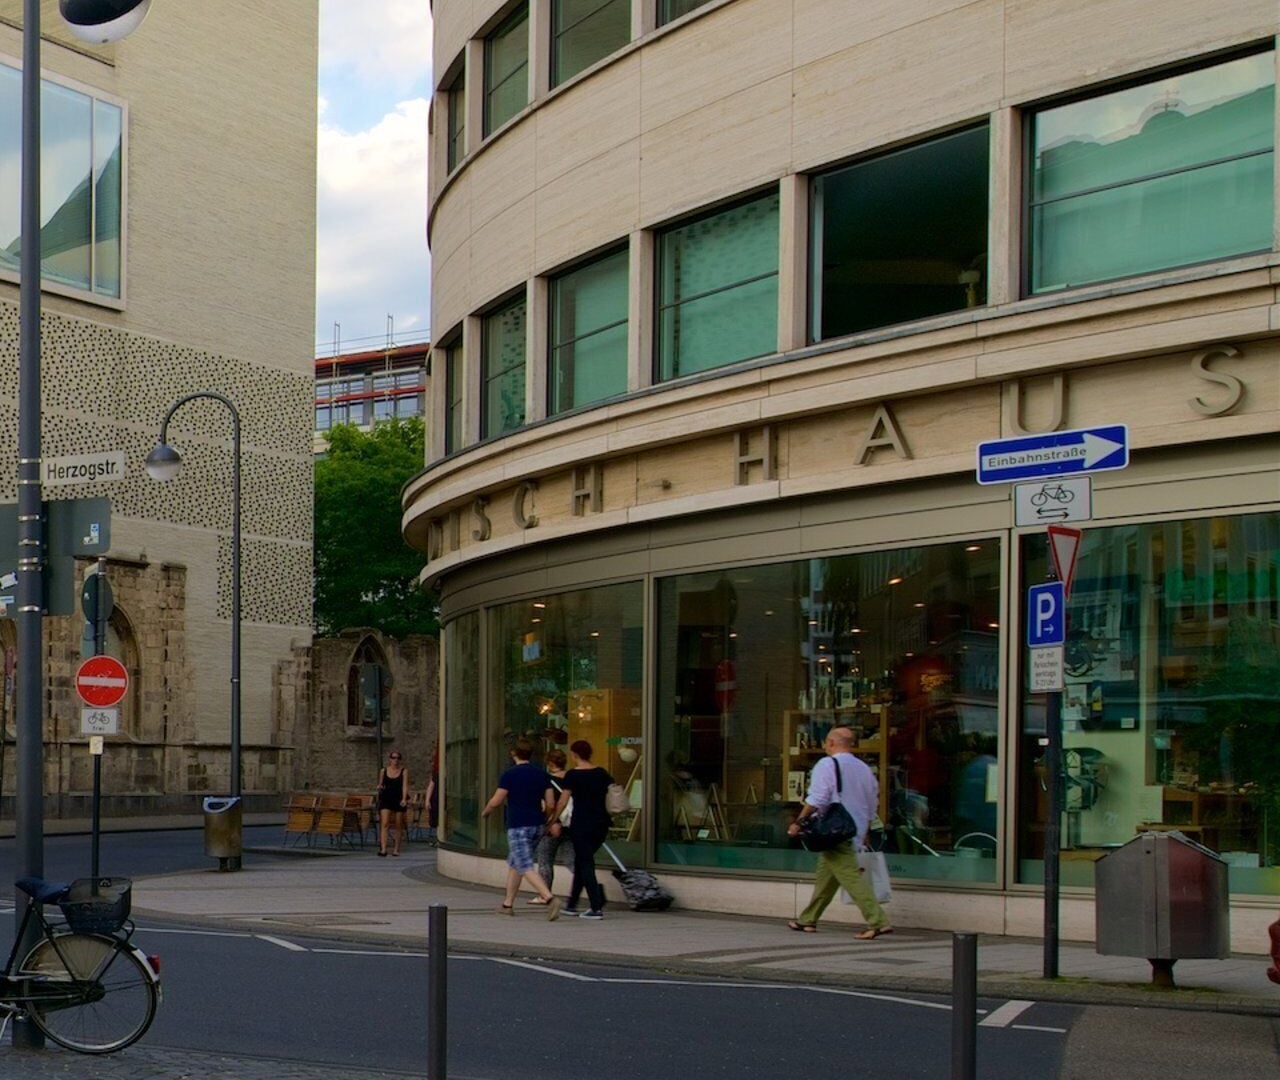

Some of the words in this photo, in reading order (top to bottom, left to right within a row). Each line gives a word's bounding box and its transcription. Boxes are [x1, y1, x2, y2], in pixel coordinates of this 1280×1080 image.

[428, 461, 604, 560] DISCH
[733, 344, 1247, 486] HAUS
[988, 447, 1087, 468] Einbahnstraße
[47, 459, 119, 480] Herzogstr.
[1036, 592, 1056, 638] P
